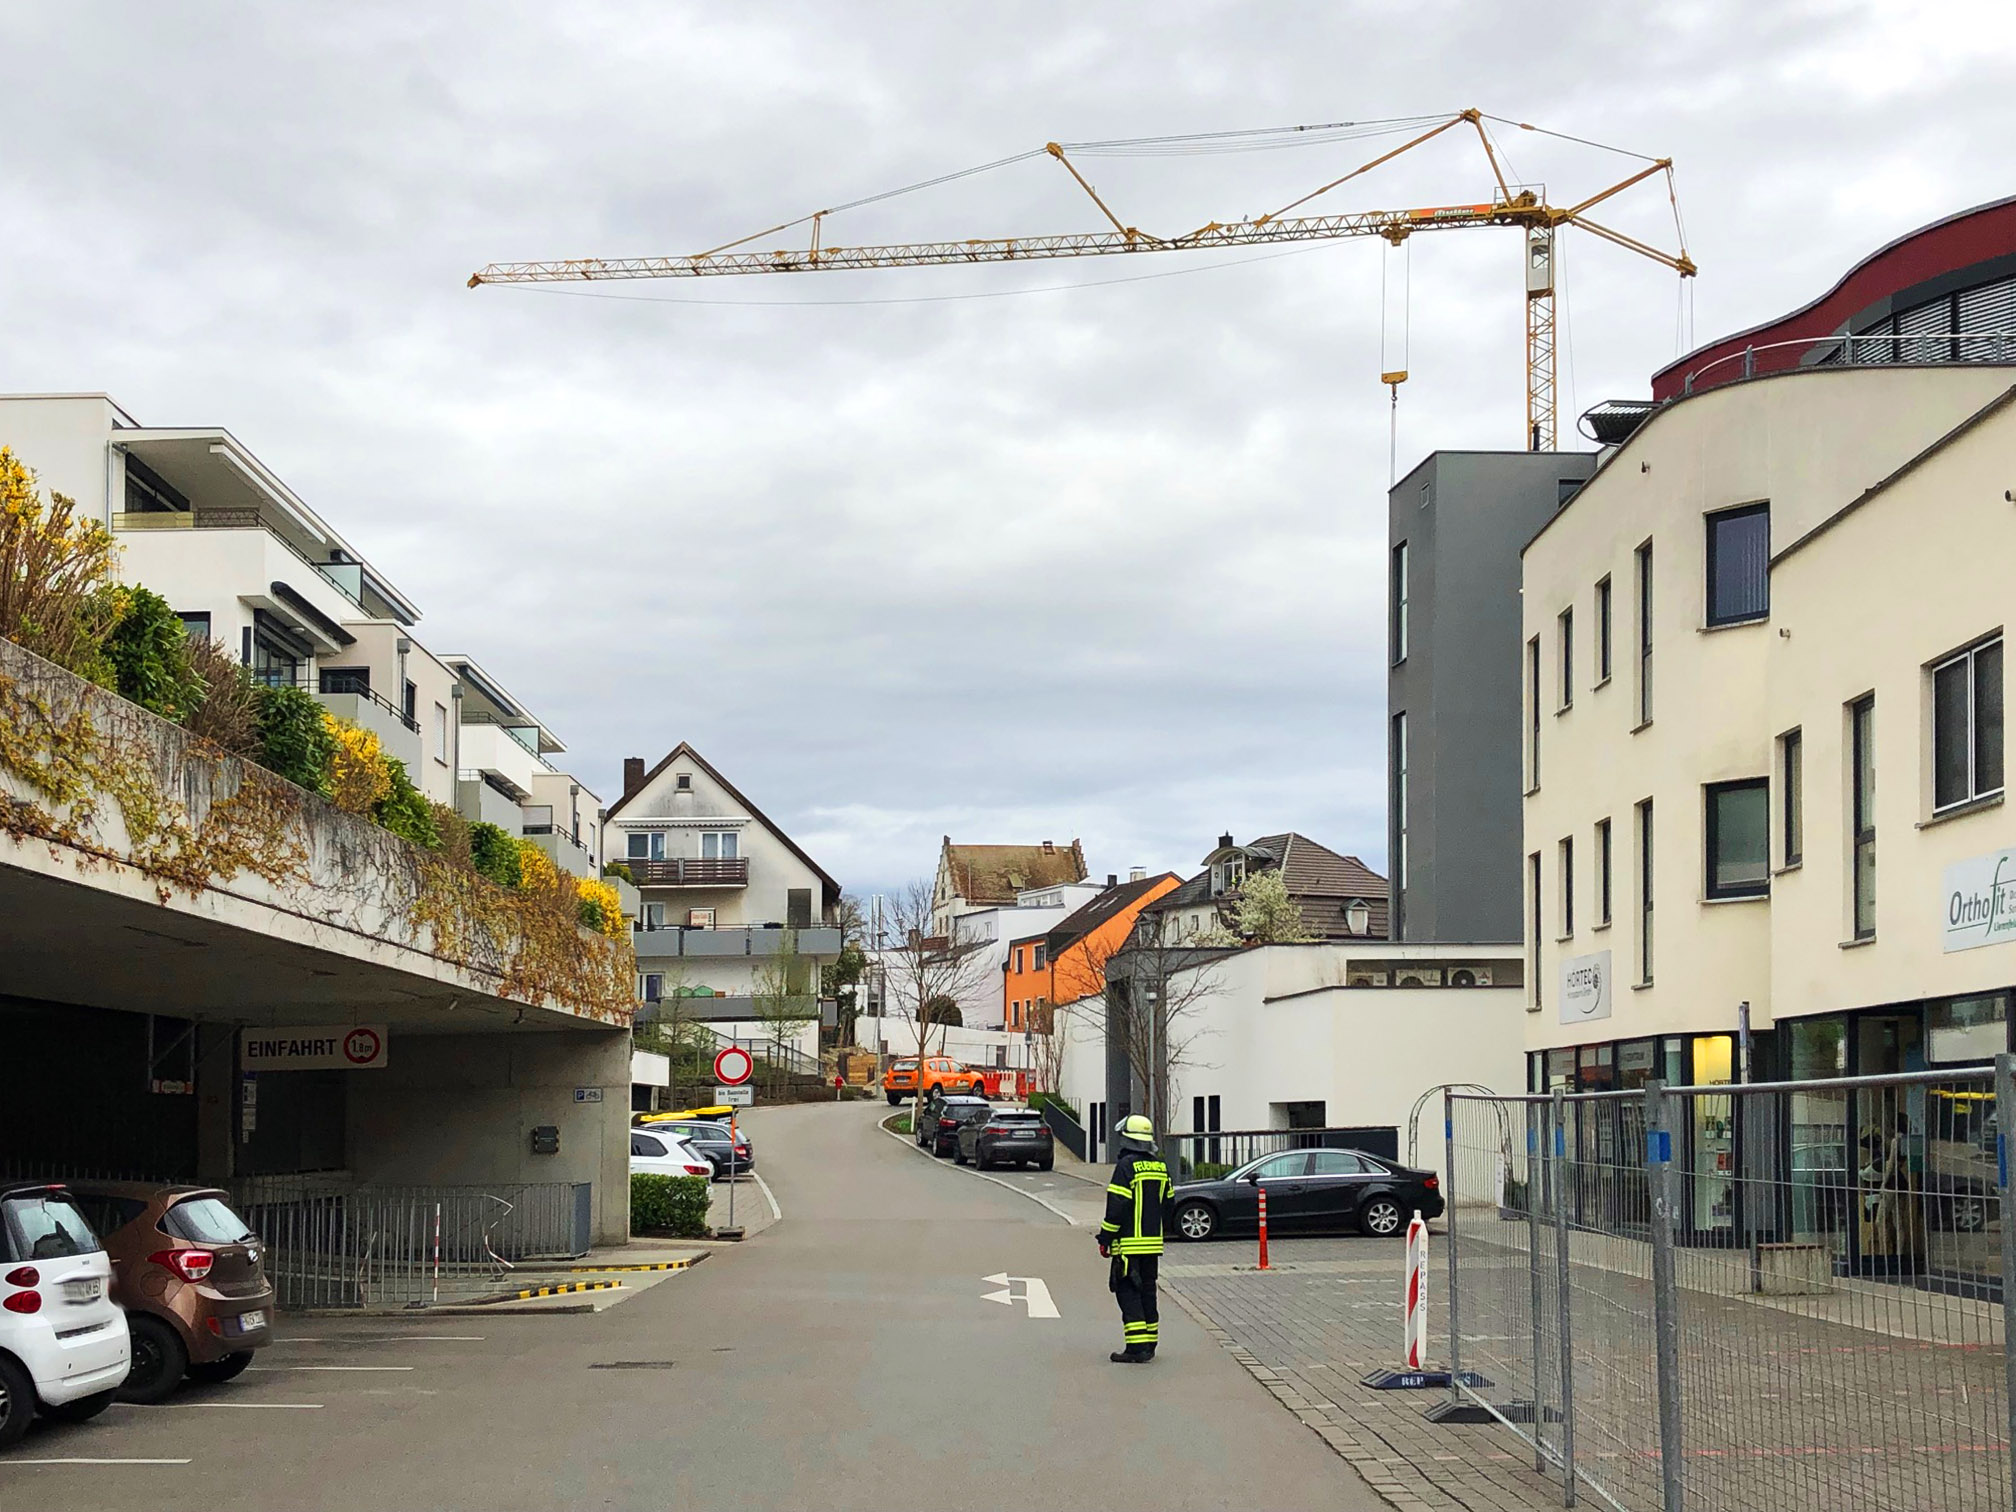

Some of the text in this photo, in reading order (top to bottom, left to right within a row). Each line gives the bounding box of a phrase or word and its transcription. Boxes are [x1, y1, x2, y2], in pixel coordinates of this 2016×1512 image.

[1949, 856, 2009, 937] Orthofit
[247, 1039, 337, 1057] EINFAHRT
[1419, 1250, 1427, 1312] REPASS
